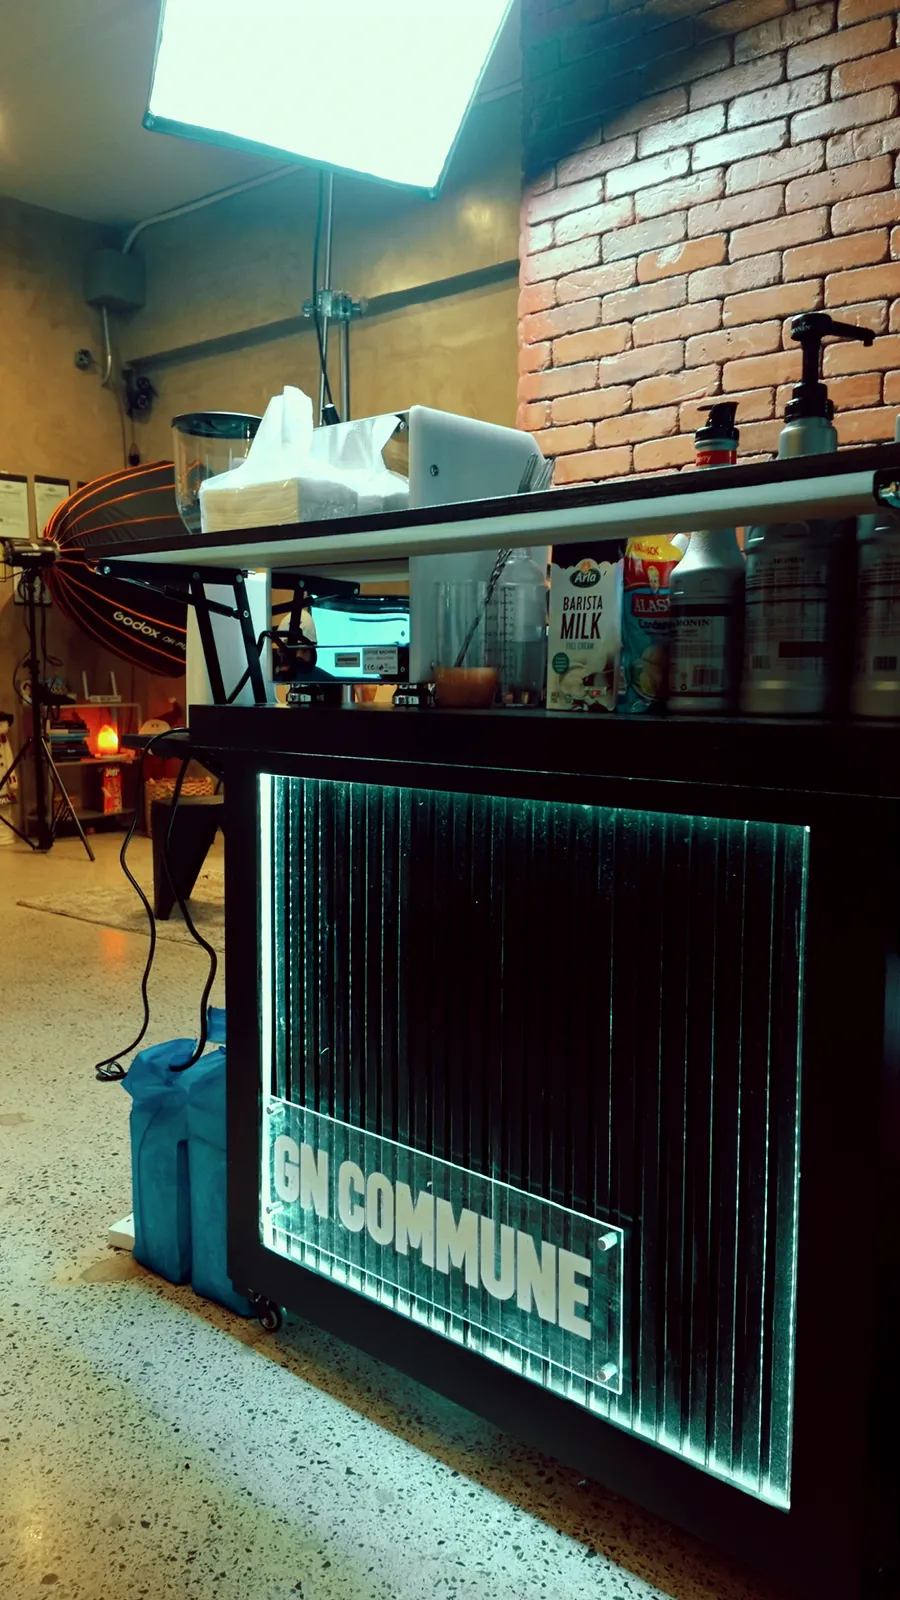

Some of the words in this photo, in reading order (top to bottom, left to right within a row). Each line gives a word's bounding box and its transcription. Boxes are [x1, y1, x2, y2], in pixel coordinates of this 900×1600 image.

[574, 571, 597, 583] Arla
[562, 595, 603, 611] BARISTA
[113, 611, 161, 639] Godox
[560, 612, 603, 640] MILK
[273, 1134, 329, 1220] GN
[338, 1160, 592, 1342] COMMUNE
